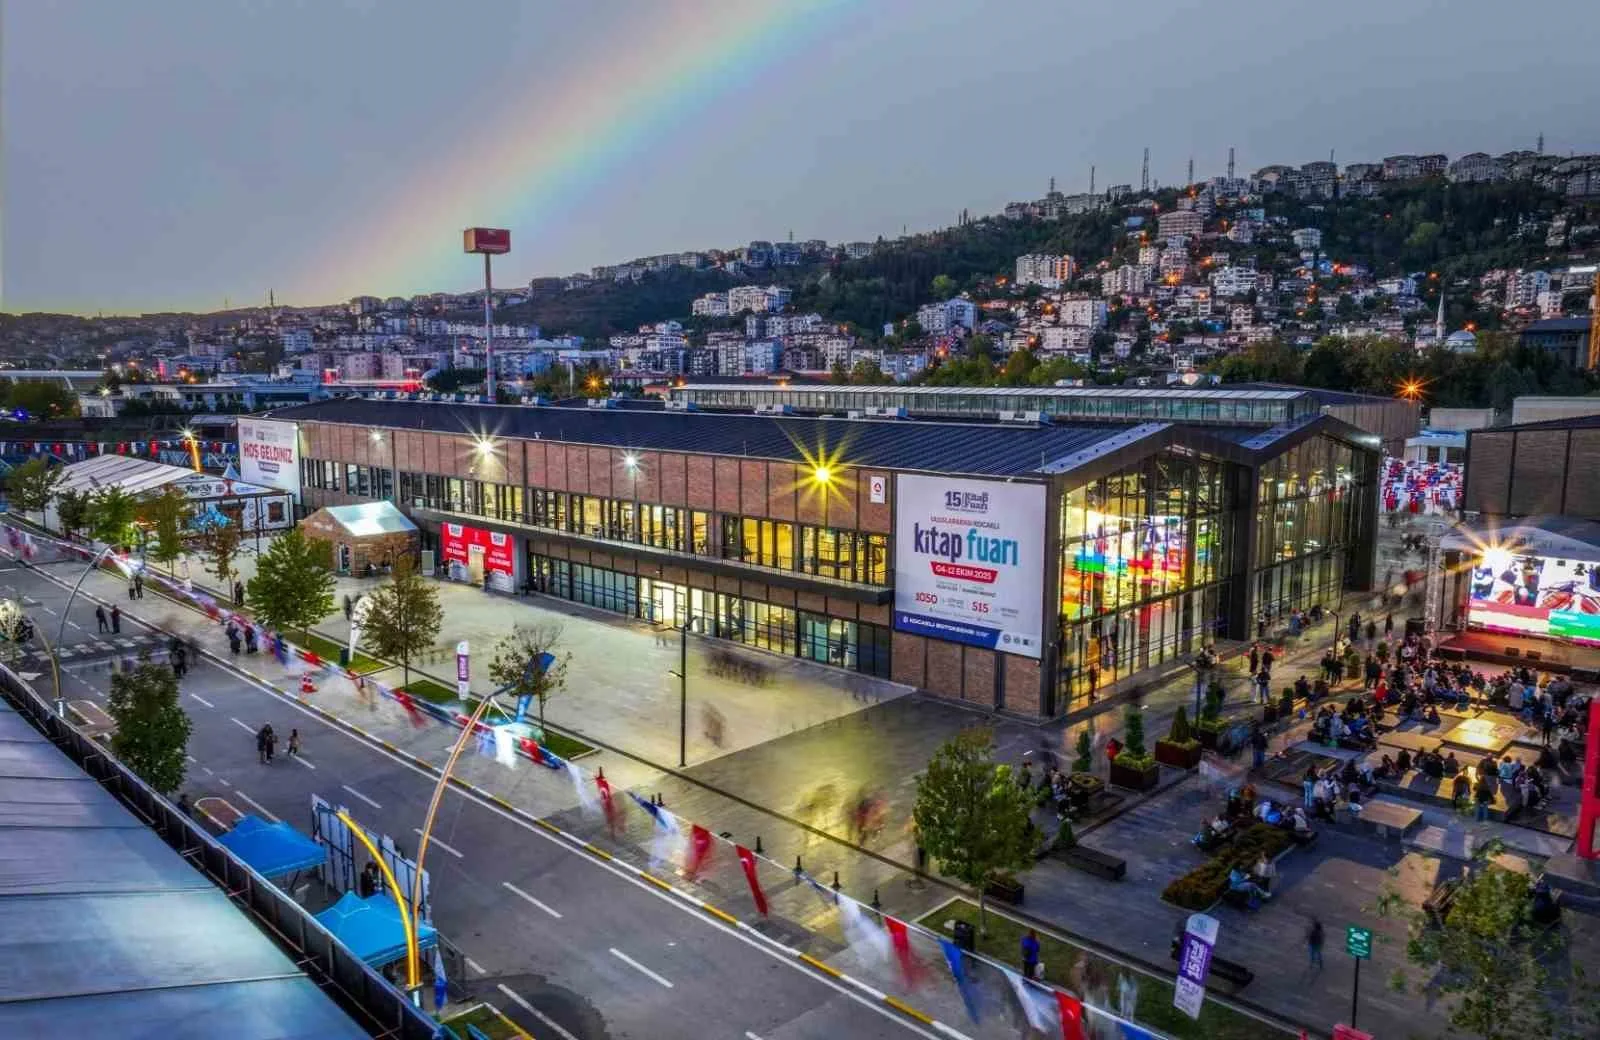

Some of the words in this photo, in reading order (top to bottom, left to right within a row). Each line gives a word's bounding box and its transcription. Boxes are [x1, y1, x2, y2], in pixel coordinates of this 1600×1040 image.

[945, 491, 961, 507] 15
[914, 522, 962, 563] kitap
[972, 601, 989, 613] 515
